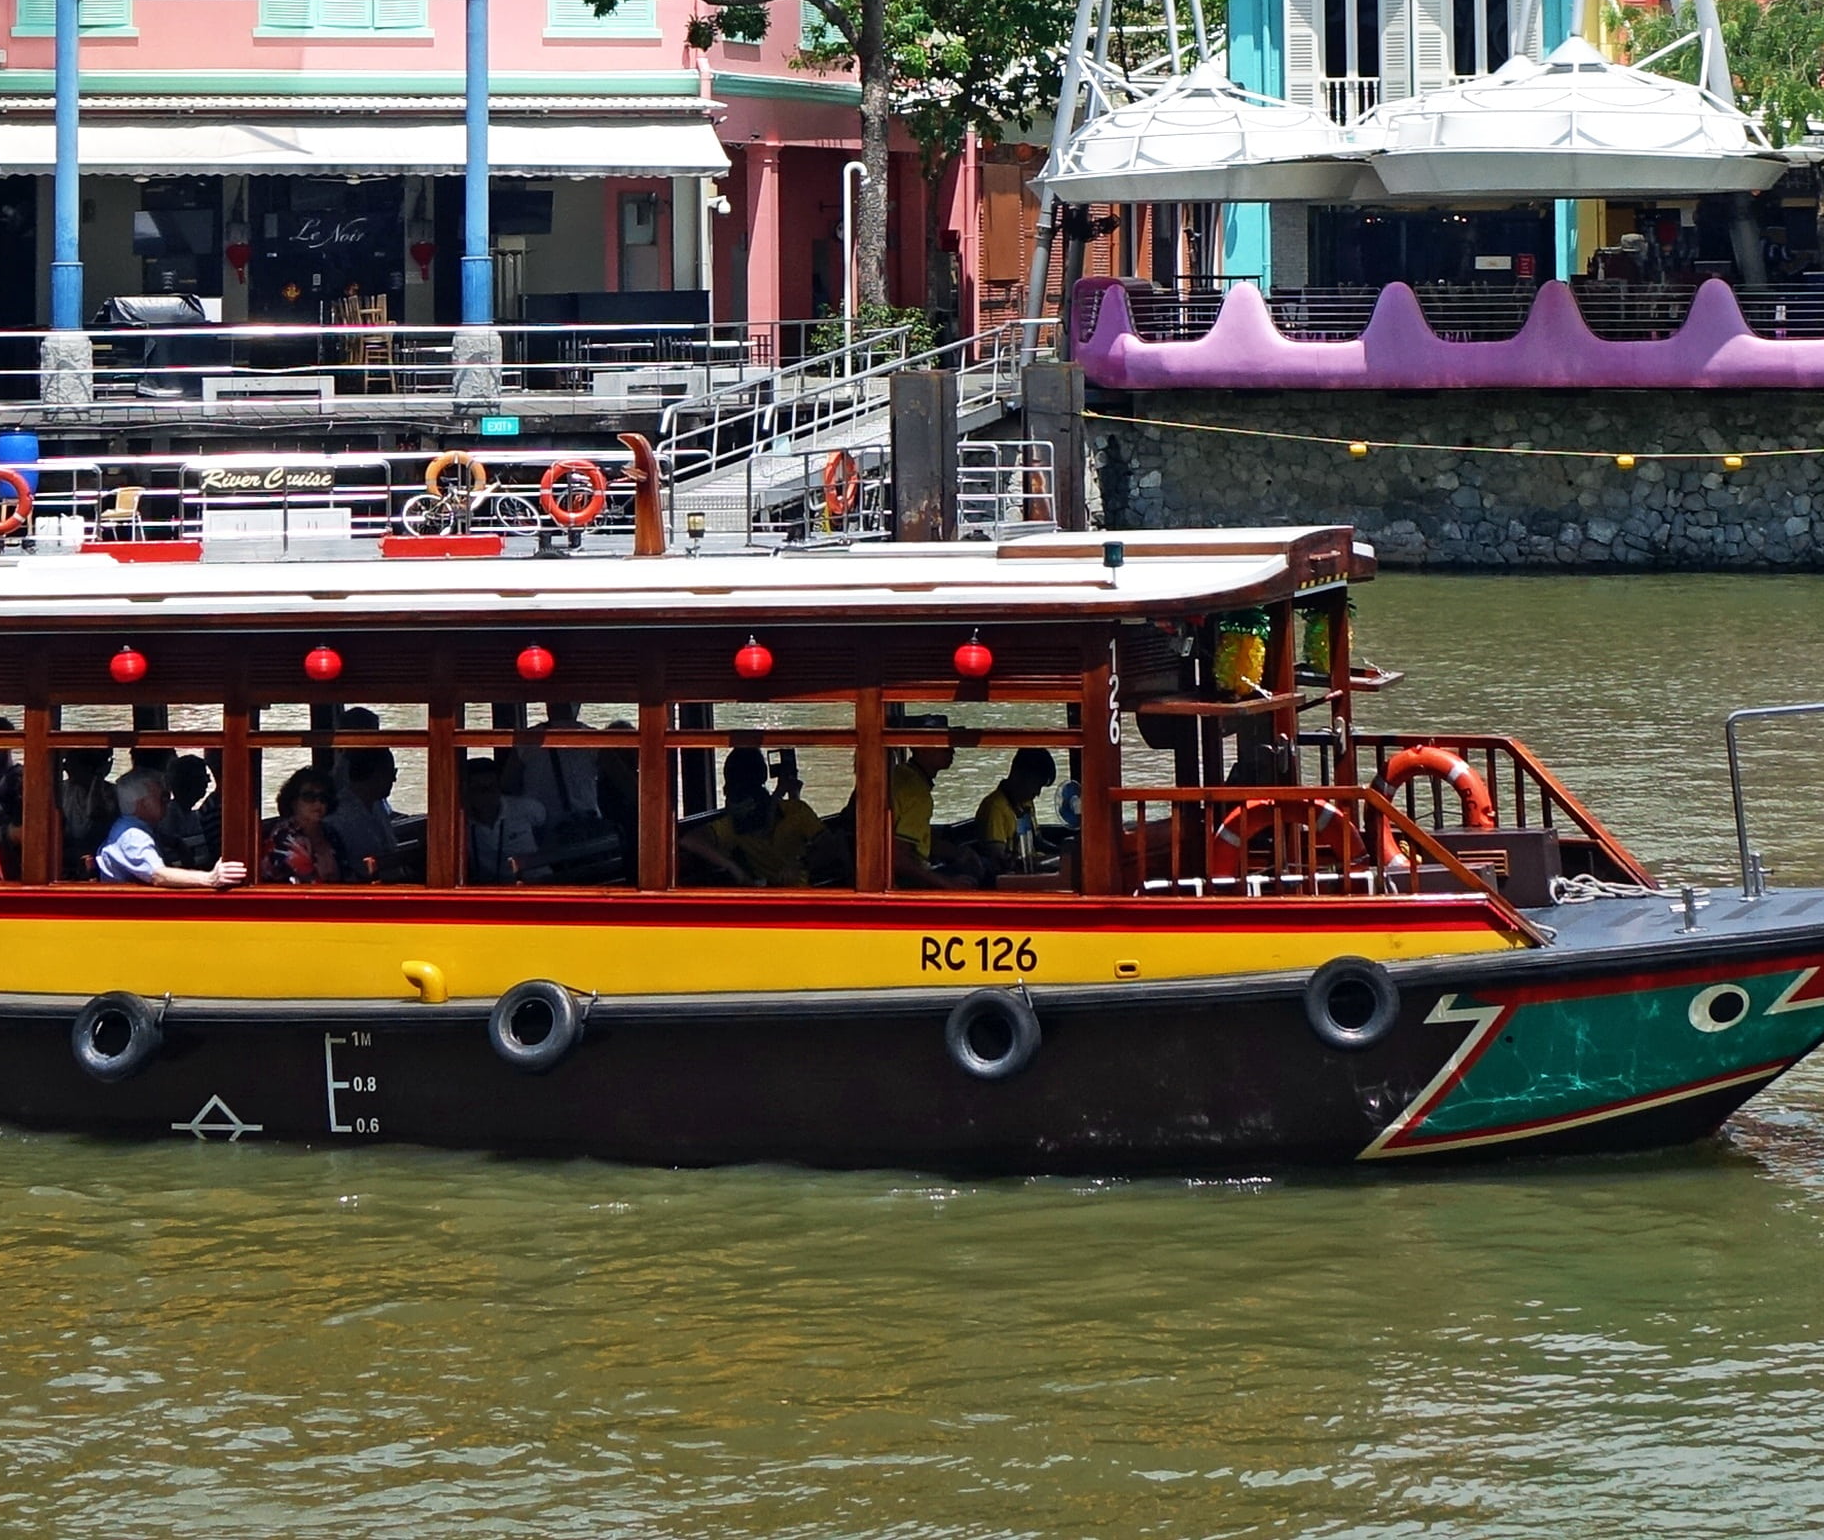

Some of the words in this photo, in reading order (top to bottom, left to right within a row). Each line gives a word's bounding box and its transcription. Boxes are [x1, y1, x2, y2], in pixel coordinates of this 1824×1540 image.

[200, 468, 261, 490] River
[1109, 638, 1120, 745] 126
[921, 936, 966, 971] RC
[975, 936, 1037, 972] 126
[352, 1031, 372, 1047] 1M
[353, 1077, 376, 1092] 0.8
[356, 1118, 380, 1133] 0.6
